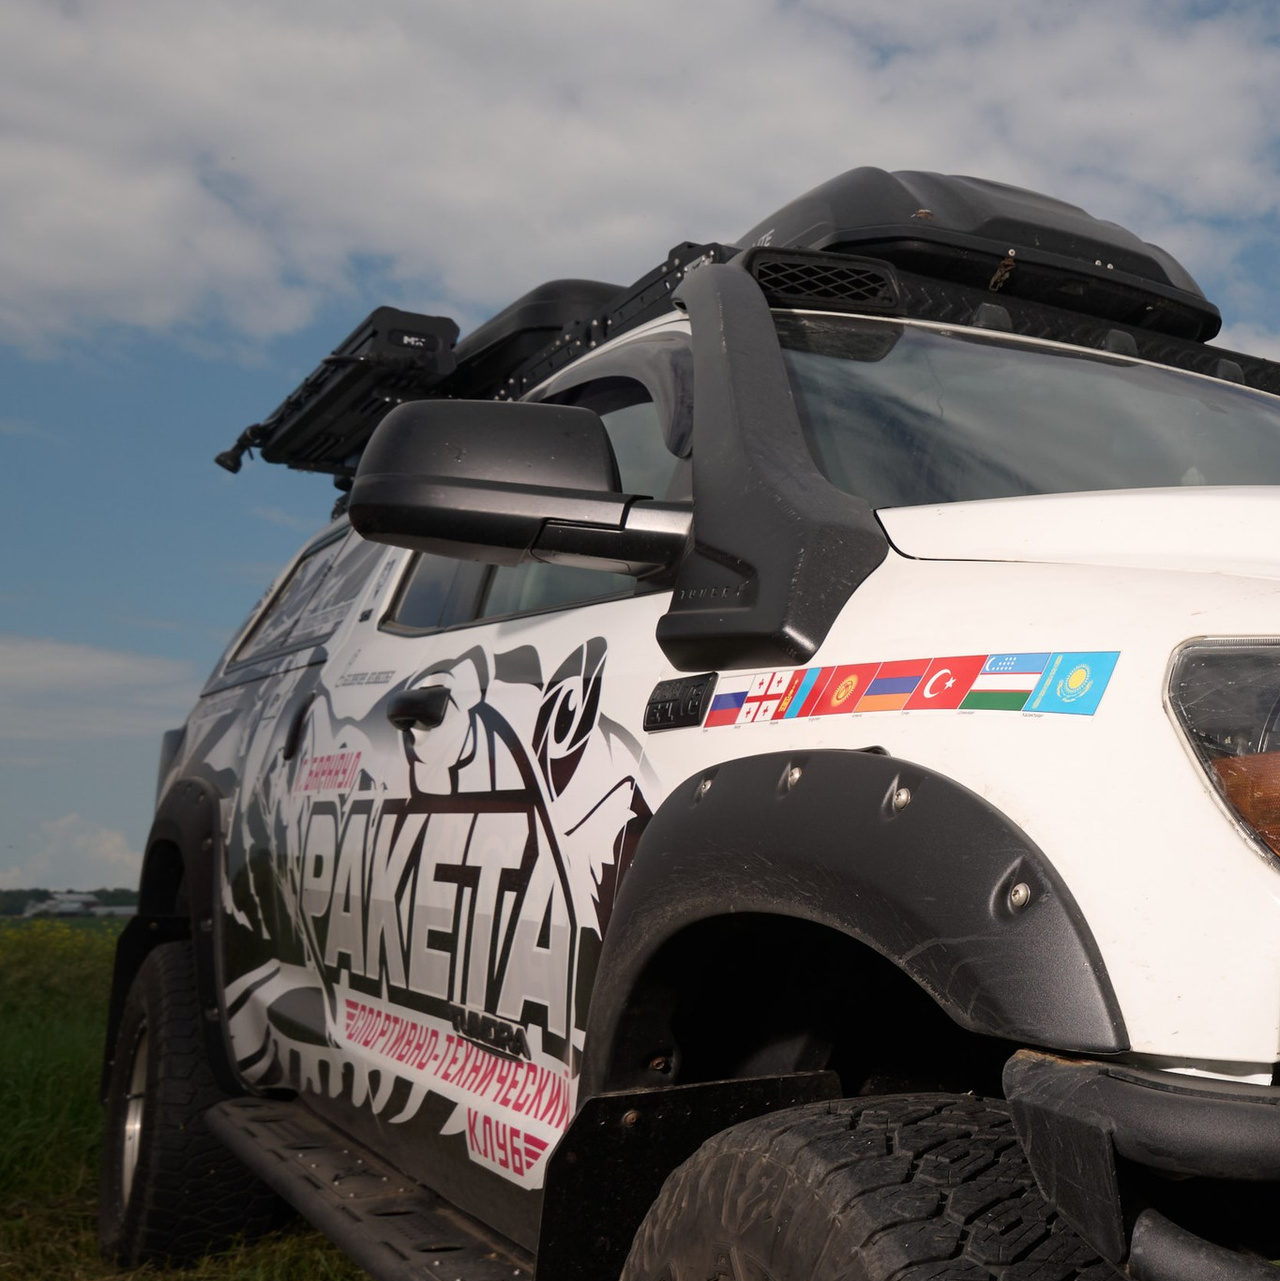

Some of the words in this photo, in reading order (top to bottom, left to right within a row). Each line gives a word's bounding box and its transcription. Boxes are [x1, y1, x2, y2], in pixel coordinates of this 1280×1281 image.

[301, 806, 572, 1039] РАКЕТА
[346, 1005, 571, 1132] СПОРТИВНО-ТЕХНИЧЕСКИЙ
[467, 1107, 525, 1177] КЛУБ
